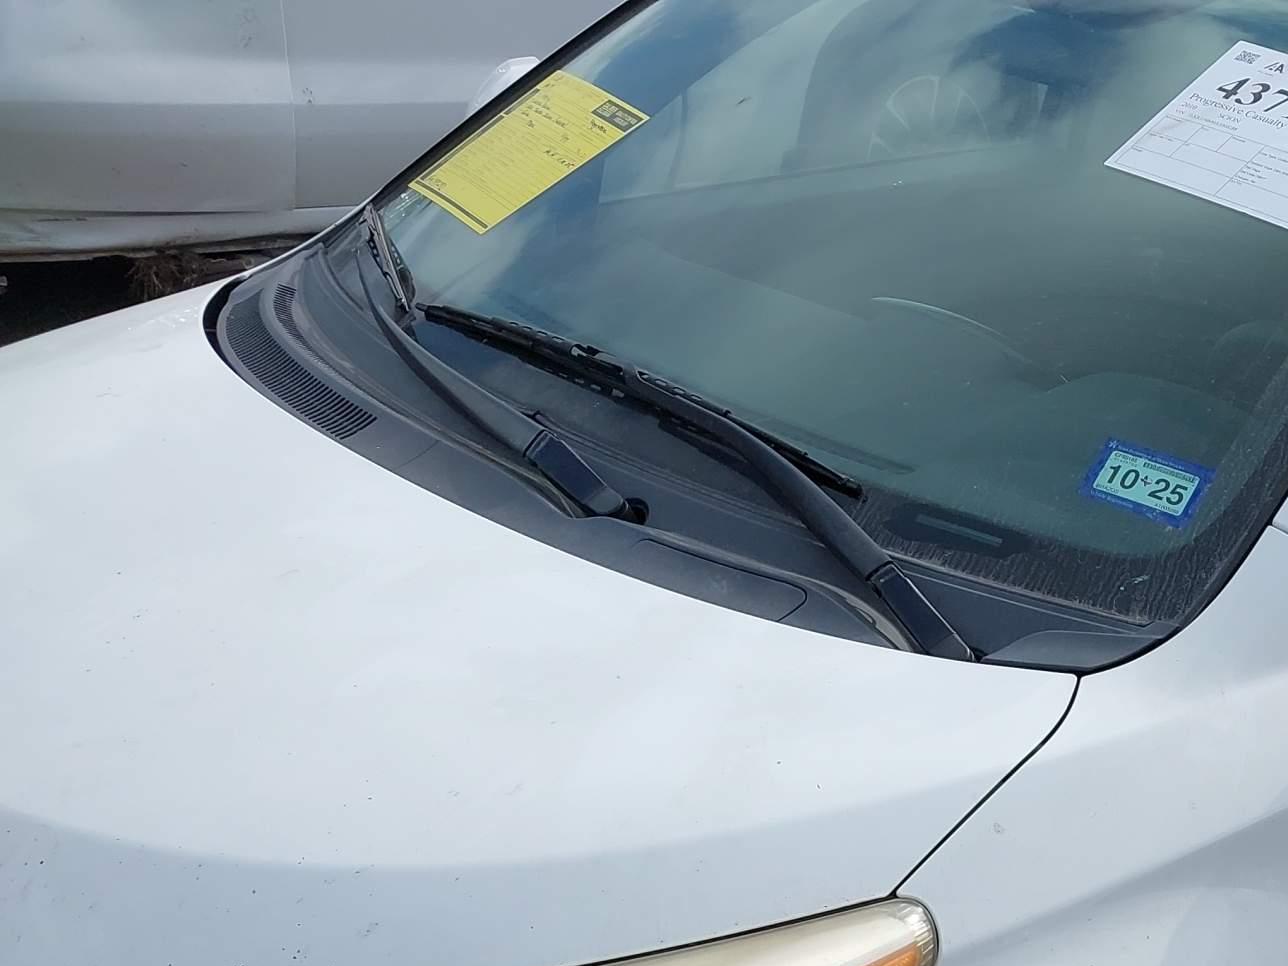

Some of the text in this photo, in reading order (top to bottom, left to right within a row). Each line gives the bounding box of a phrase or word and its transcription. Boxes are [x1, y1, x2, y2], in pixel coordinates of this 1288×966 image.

[1189, 92, 1245, 115] Progressive
[1245, 110, 1288, 129] Casualty
[1106, 463, 1140, 490] 10
[1147, 477, 1188, 506] 25
